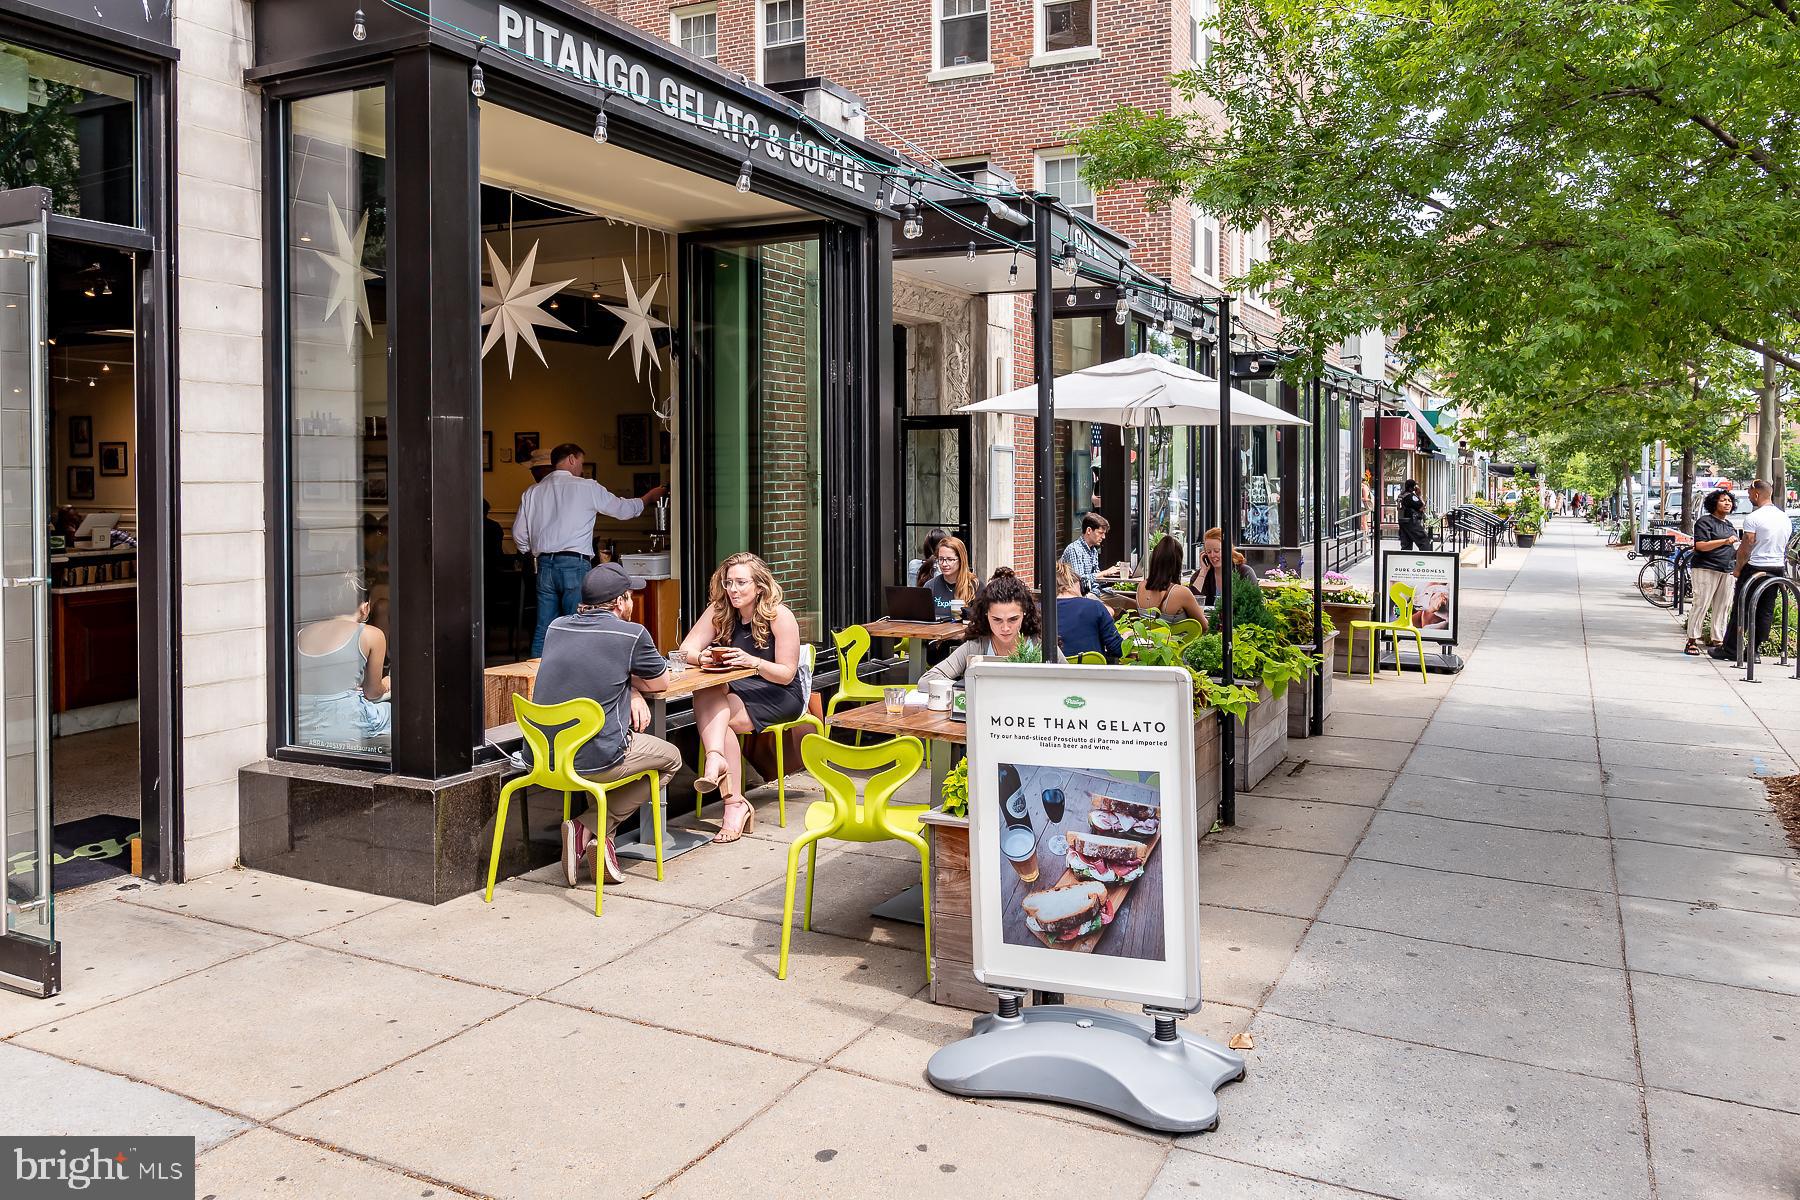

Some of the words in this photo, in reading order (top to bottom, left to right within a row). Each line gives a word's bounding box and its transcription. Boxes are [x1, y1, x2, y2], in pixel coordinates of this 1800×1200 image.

[499, 4, 650, 105] PITANGO
[659, 77, 760, 150] GELATO
[765, 124, 785, 161] &
[789, 133, 866, 193] COFFEE
[990, 715, 1036, 728] MORE
[1043, 717, 1088, 730] THAN
[1096, 719, 1166, 733] GELATO
[990, 732, 1000, 740] Try
[1097, 737, 1120, 745] Parma
[1135, 740, 1168, 748] imported
